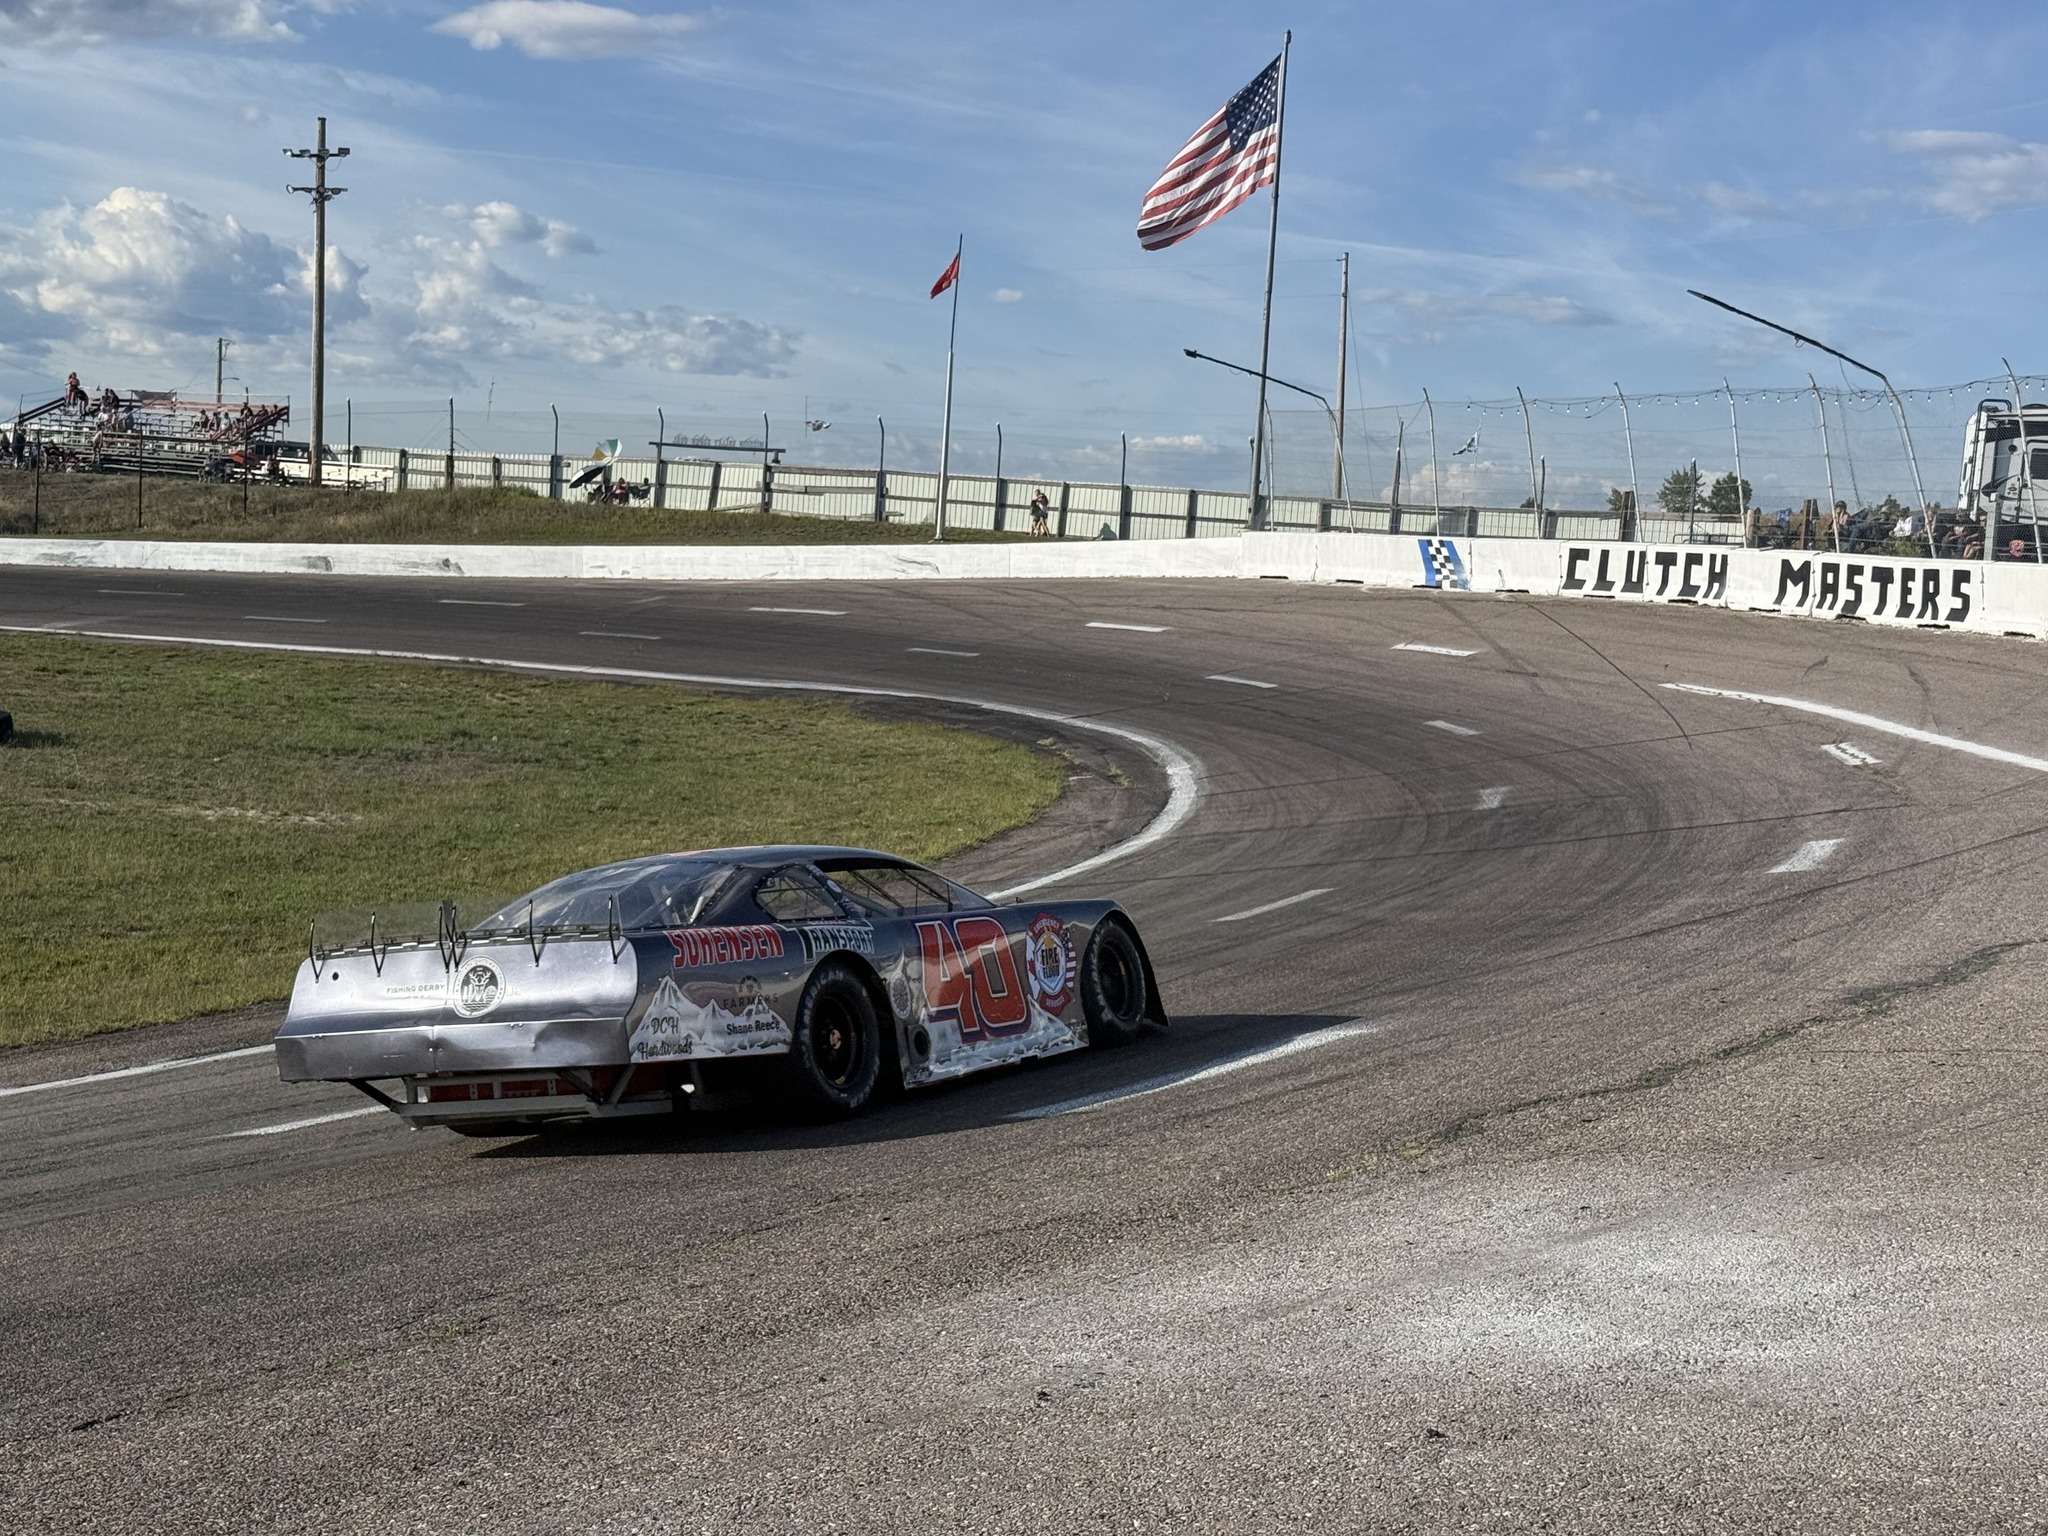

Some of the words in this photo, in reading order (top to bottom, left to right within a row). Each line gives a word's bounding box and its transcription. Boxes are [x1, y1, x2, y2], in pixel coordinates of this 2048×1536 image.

[1563, 547, 1729, 599] CLUTCH
[1774, 558, 1972, 622] MASTERS
[664, 924, 785, 969] SORENSEN
[773, 918, 876, 963] TRANSPORT
[1041, 947, 1059, 966] FIRE
[386, 985, 417, 994] FISHING
[418, 983, 445, 992] DERBY
[915, 916, 1030, 1034] 40
[723, 993, 779, 1009] FARMERS
[726, 1022, 754, 1036] Shane
[755, 1019, 781, 1032] Reece
